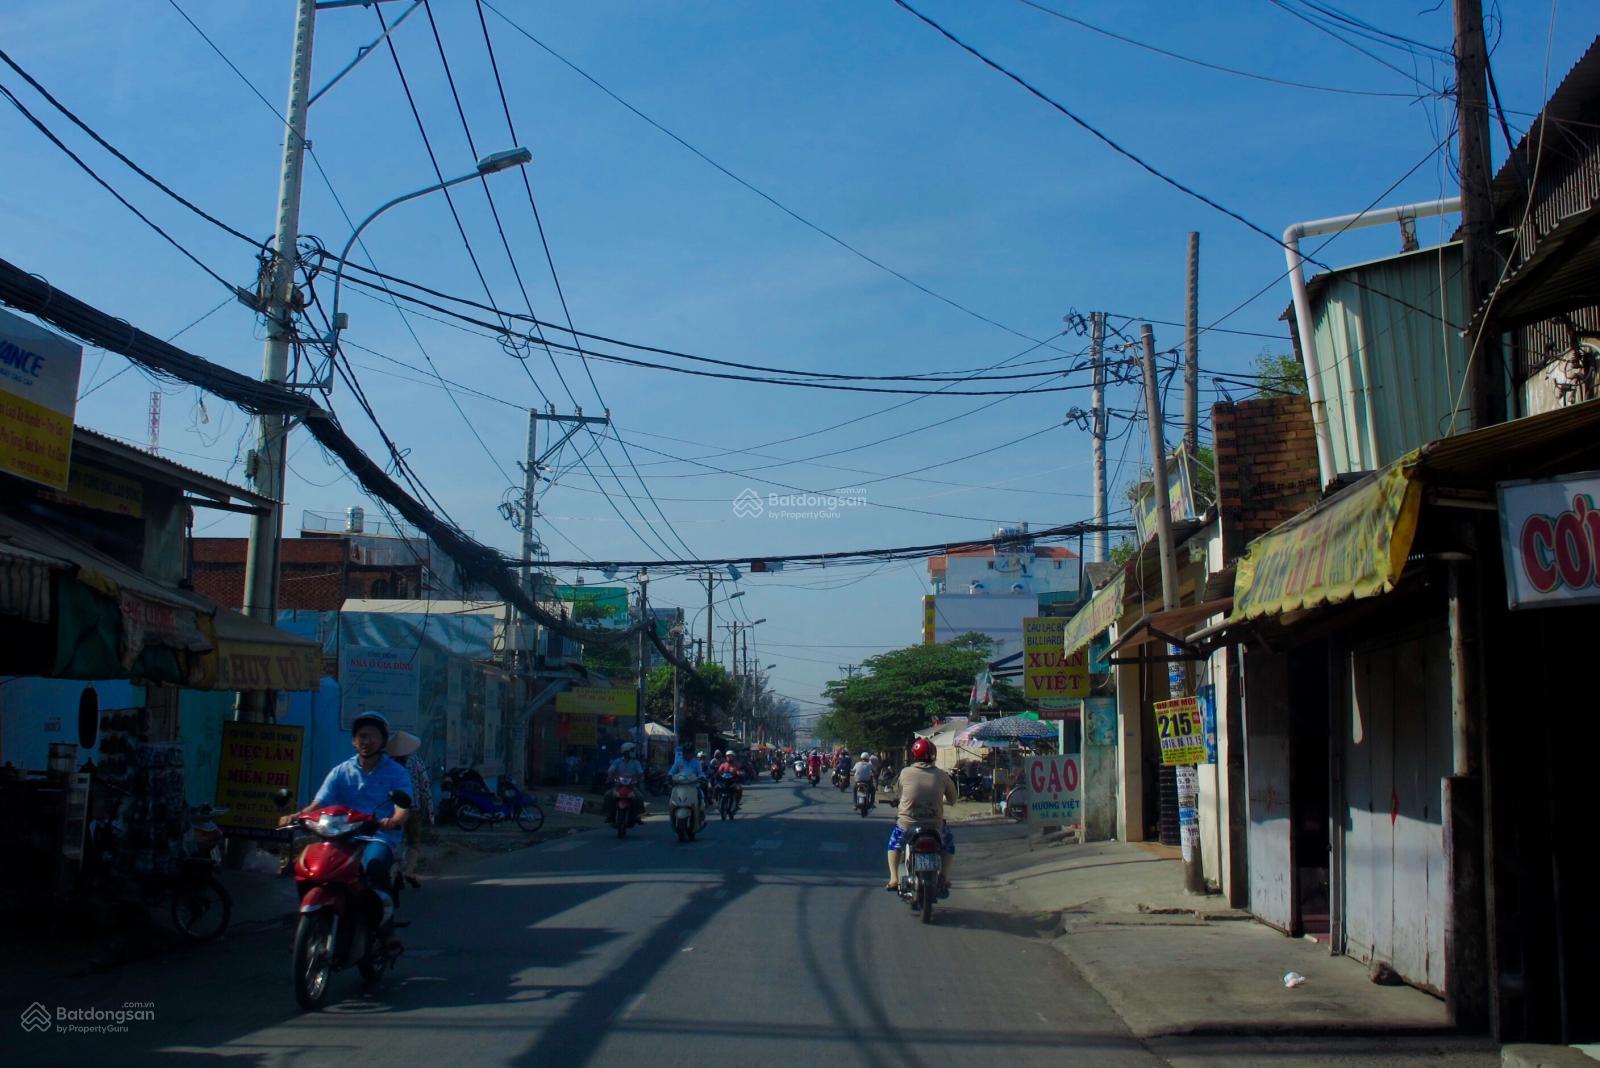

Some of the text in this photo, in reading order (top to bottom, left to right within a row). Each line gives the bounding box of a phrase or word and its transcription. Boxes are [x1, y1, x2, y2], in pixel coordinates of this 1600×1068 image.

[1028, 648, 1083, 668] XUÂN
[1032, 671, 1081, 694] VIỆT
[1158, 713, 1192, 738] 215
[1031, 758, 1078, 800] GẠO
